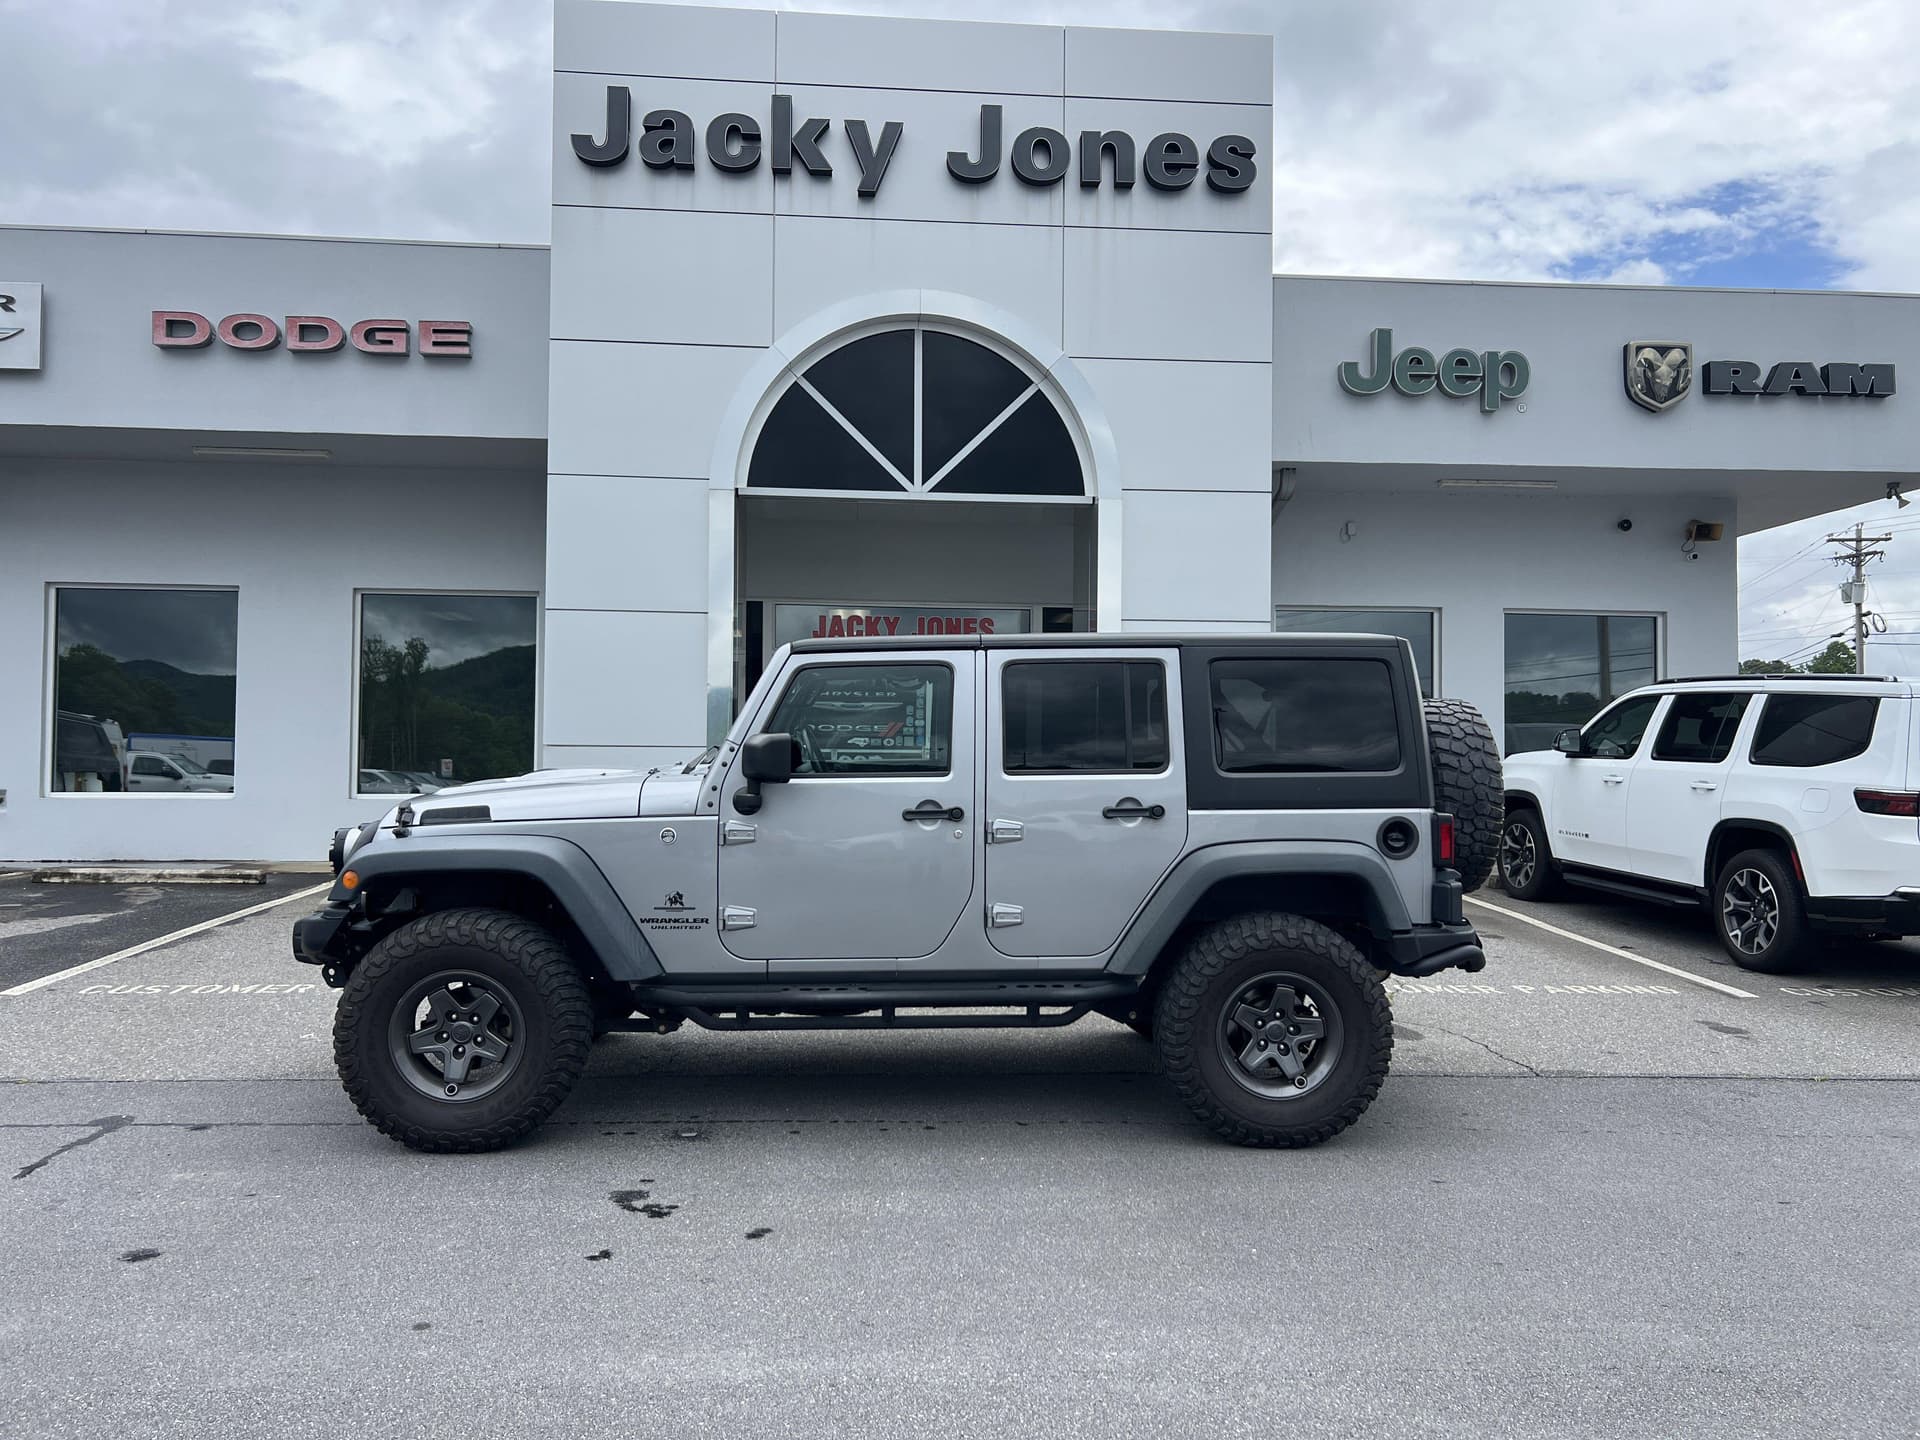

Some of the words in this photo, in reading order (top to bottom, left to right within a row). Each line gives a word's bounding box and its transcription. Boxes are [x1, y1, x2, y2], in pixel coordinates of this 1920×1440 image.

[570, 85, 904, 197] Jacky
[947, 103, 1258, 193] Jones
[151, 310, 473, 359] DODGE
[1337, 328, 1531, 413] Jeep
[1702, 360, 1896, 398] RAM
[812, 614, 900, 639] JACKY
[911, 616, 995, 635] JONES
[640, 917, 709, 925] WRANGLER
[78, 984, 316, 995] CUSTOMER
